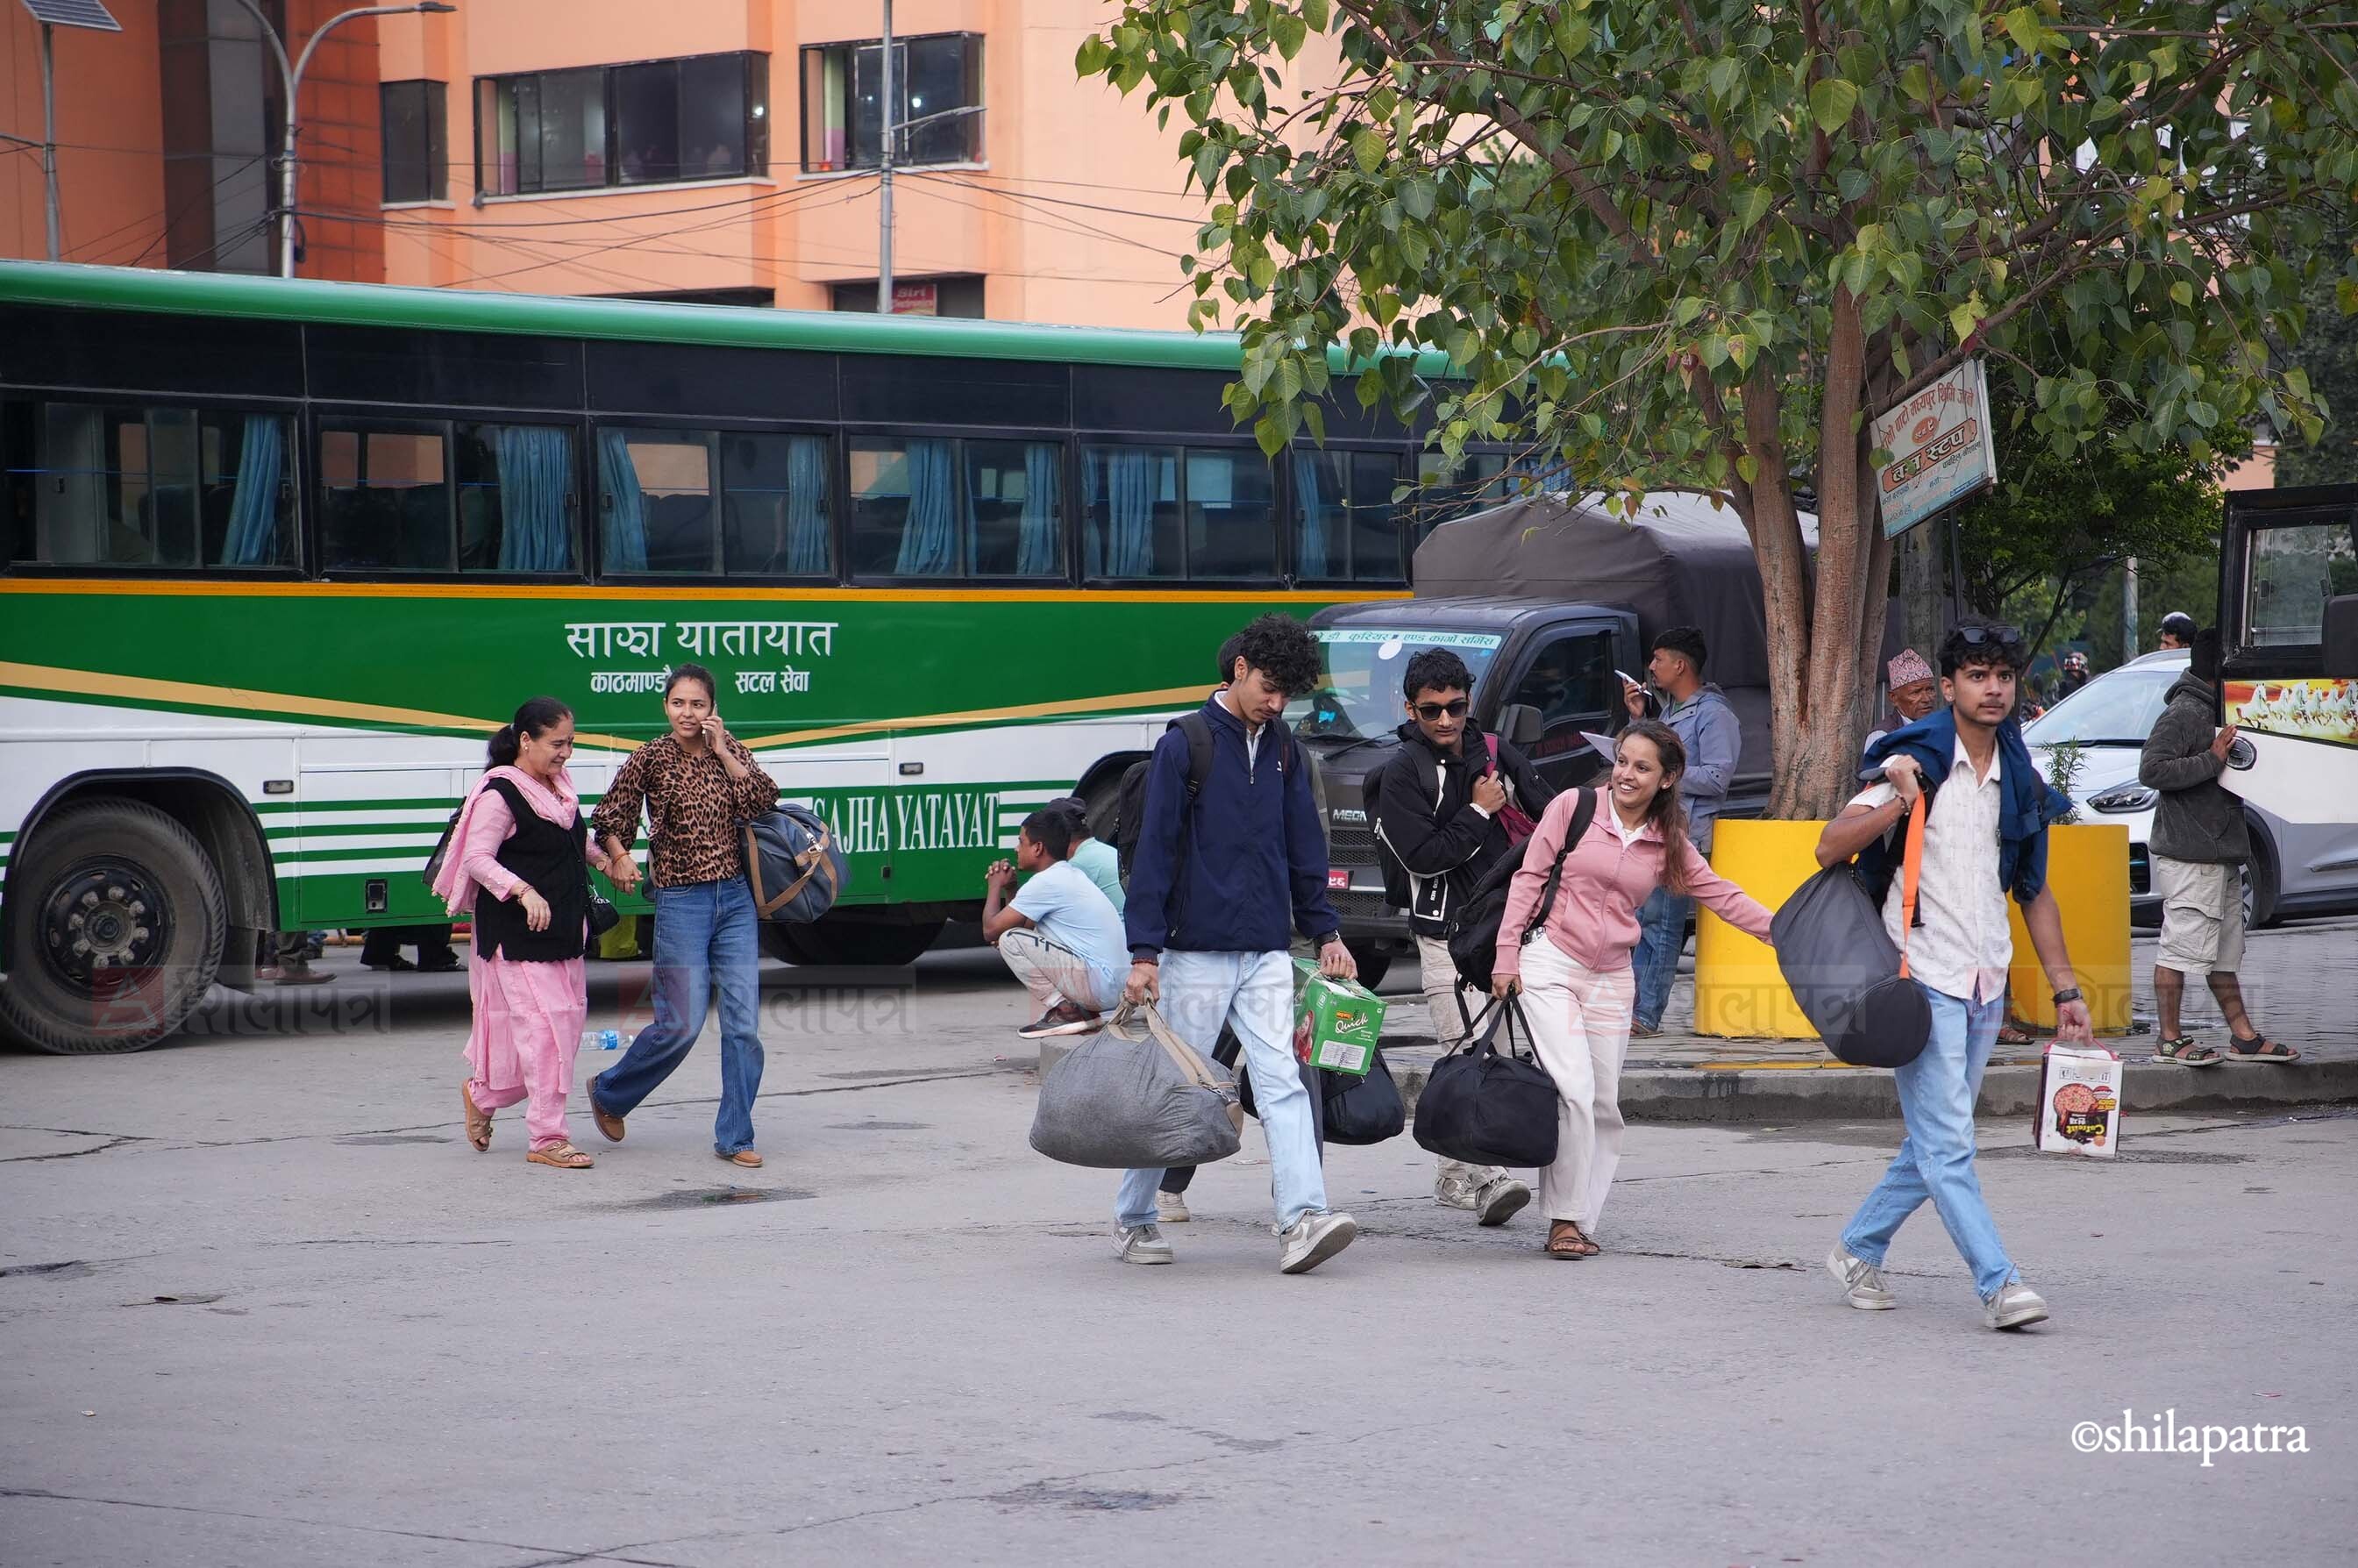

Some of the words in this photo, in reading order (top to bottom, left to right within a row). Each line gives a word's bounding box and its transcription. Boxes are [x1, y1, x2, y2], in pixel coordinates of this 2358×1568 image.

[1925, 427, 1964, 461] स्टप
[565, 623, 666, 658] साझा
[676, 622, 838, 656] यातायात
[735, 671, 776, 694] सटल
[780, 665, 810, 693] सेवा
[894, 792, 999, 851] YATAYAT
[1336, 1013, 1368, 1033] Quick
